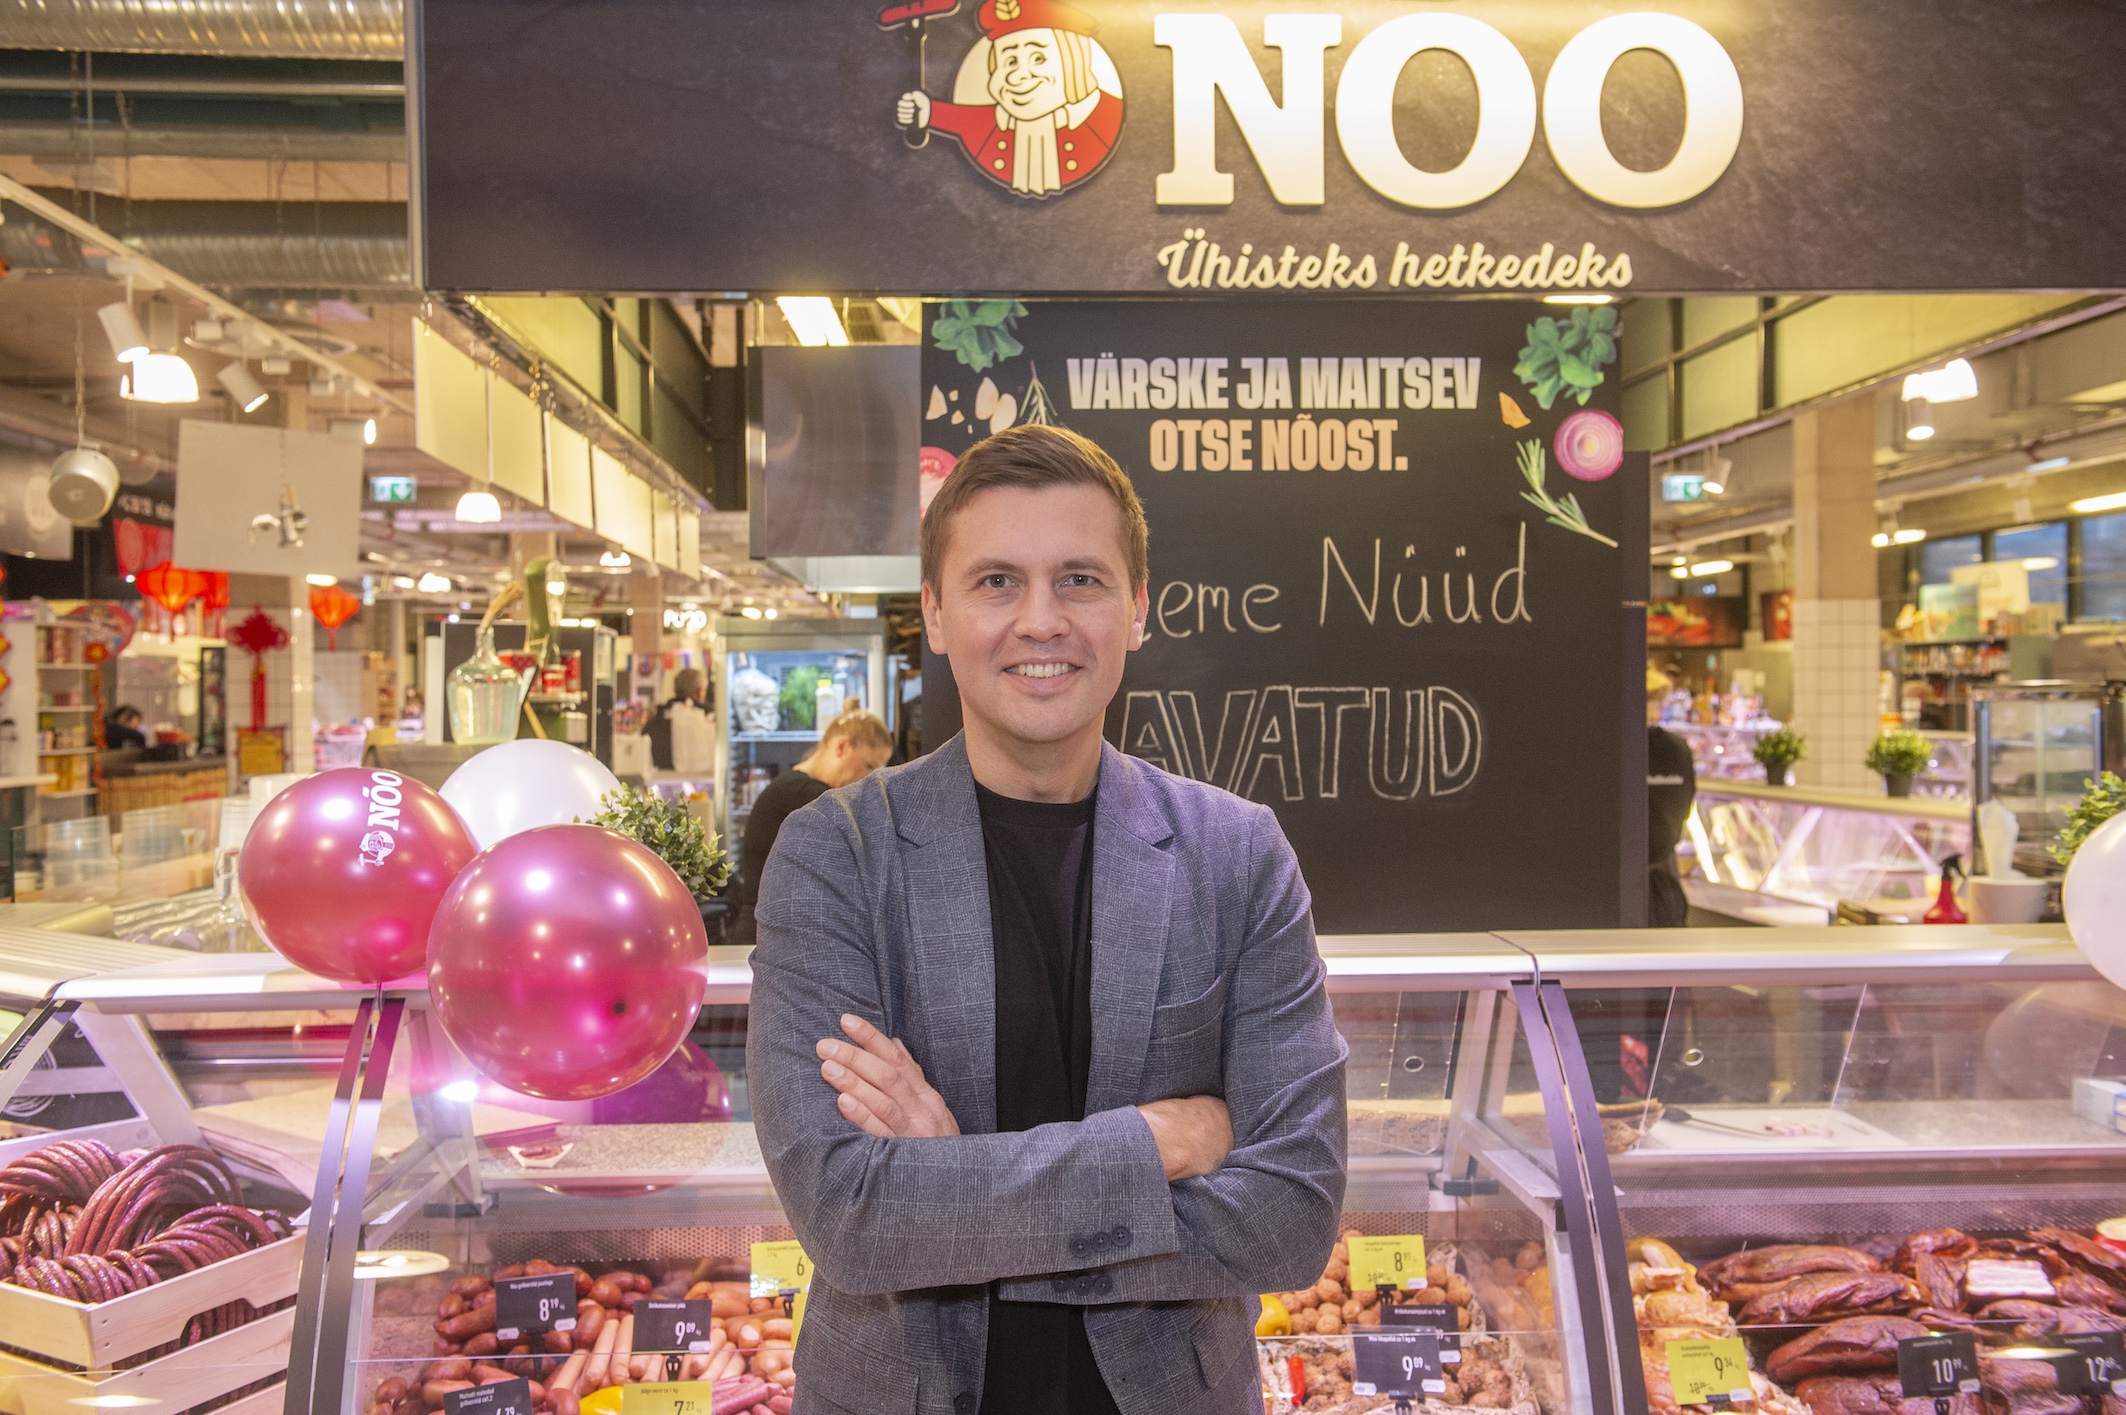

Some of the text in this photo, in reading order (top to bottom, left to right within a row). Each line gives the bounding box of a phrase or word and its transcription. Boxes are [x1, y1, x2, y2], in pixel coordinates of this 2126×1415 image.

[1157, 228, 1633, 289] Ühisteks hetkedeks
[1066, 352, 1481, 410] VÄRSKE JA MAITSEV
[1149, 413, 1408, 472] OTSE NÕOST.
[1143, 521, 1532, 641] eme Nüüd
[1119, 685, 1482, 800] AVATUD
